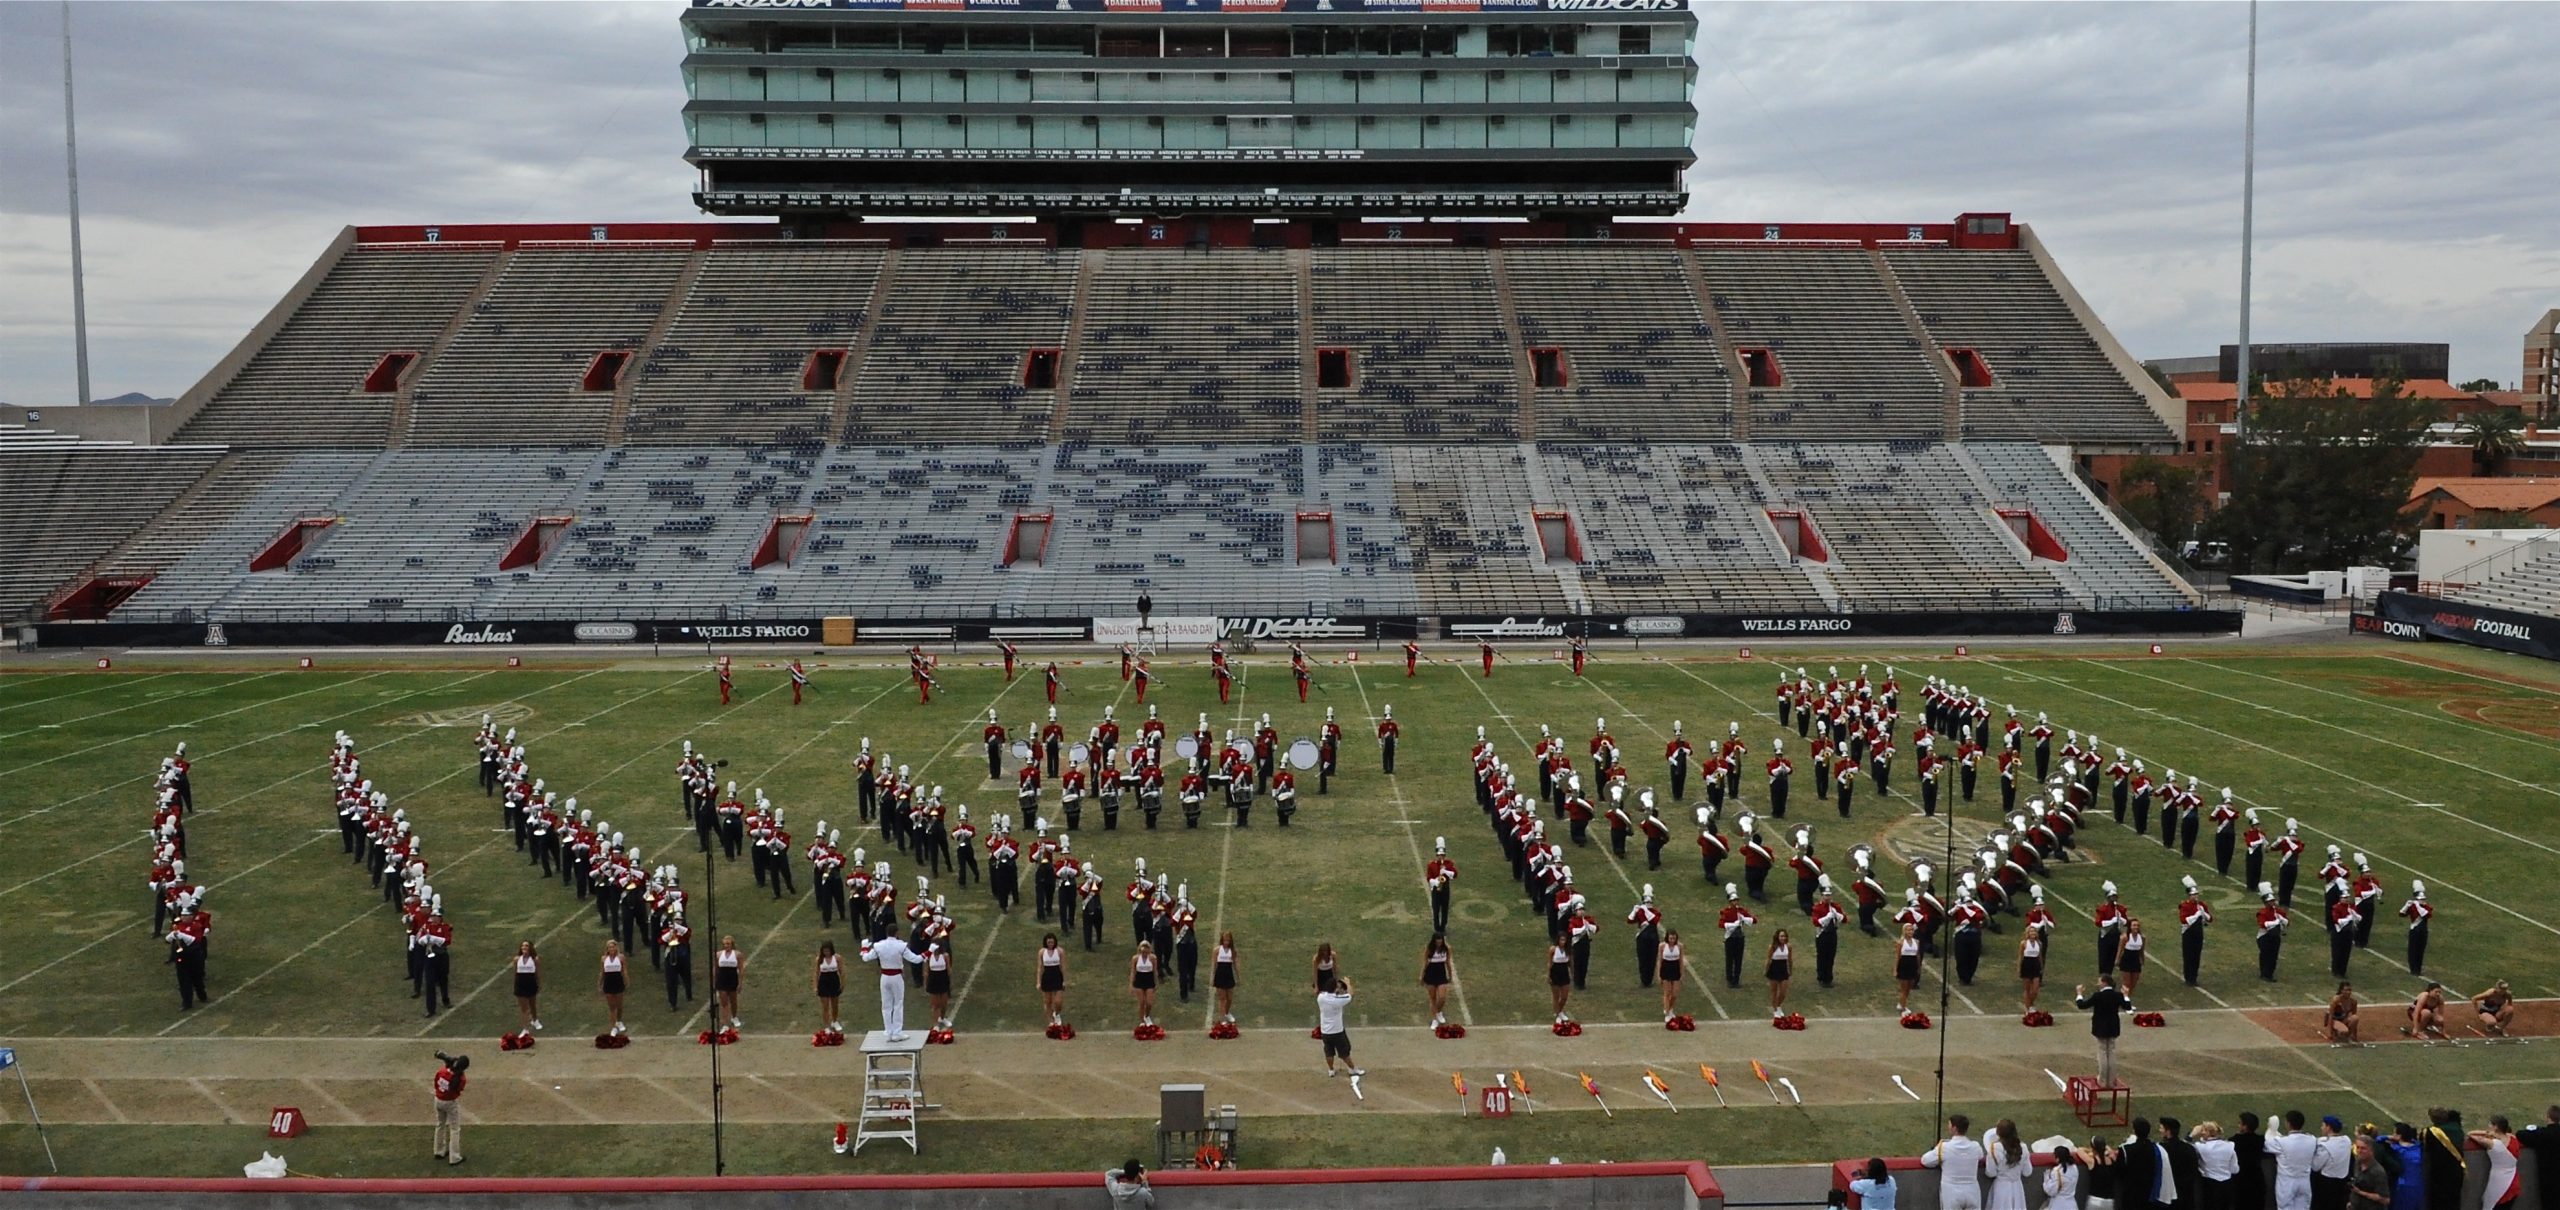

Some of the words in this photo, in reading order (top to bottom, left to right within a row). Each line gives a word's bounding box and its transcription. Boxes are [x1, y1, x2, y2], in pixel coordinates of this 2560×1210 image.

[427, 232, 438, 242] 17
[592, 231, 605, 240] 18
[992, 230, 1006, 239] 20
[1151, 229, 1163, 239] 21
[1388, 229, 1402, 239] 22
[1596, 229, 1610, 239] 23
[1765, 231, 1778, 240] 24
[1908, 231, 1922, 240] 25
[28, 411, 39, 420] 16
[1180, 624, 1198, 635] BAND
[1200, 624, 1214, 635] DAY
[1742, 619, 1795, 631] WELLS
[1800, 619, 1851, 631] FARGO
[2474, 619, 2531, 640] FOOTBALL
[444, 623, 516, 643] Bashas'
[696, 626, 751, 637] WELLS
[755, 626, 810, 637] FARGO
[1486, 1091, 1506, 1113] 40
[272, 1112, 292, 1134] 40
